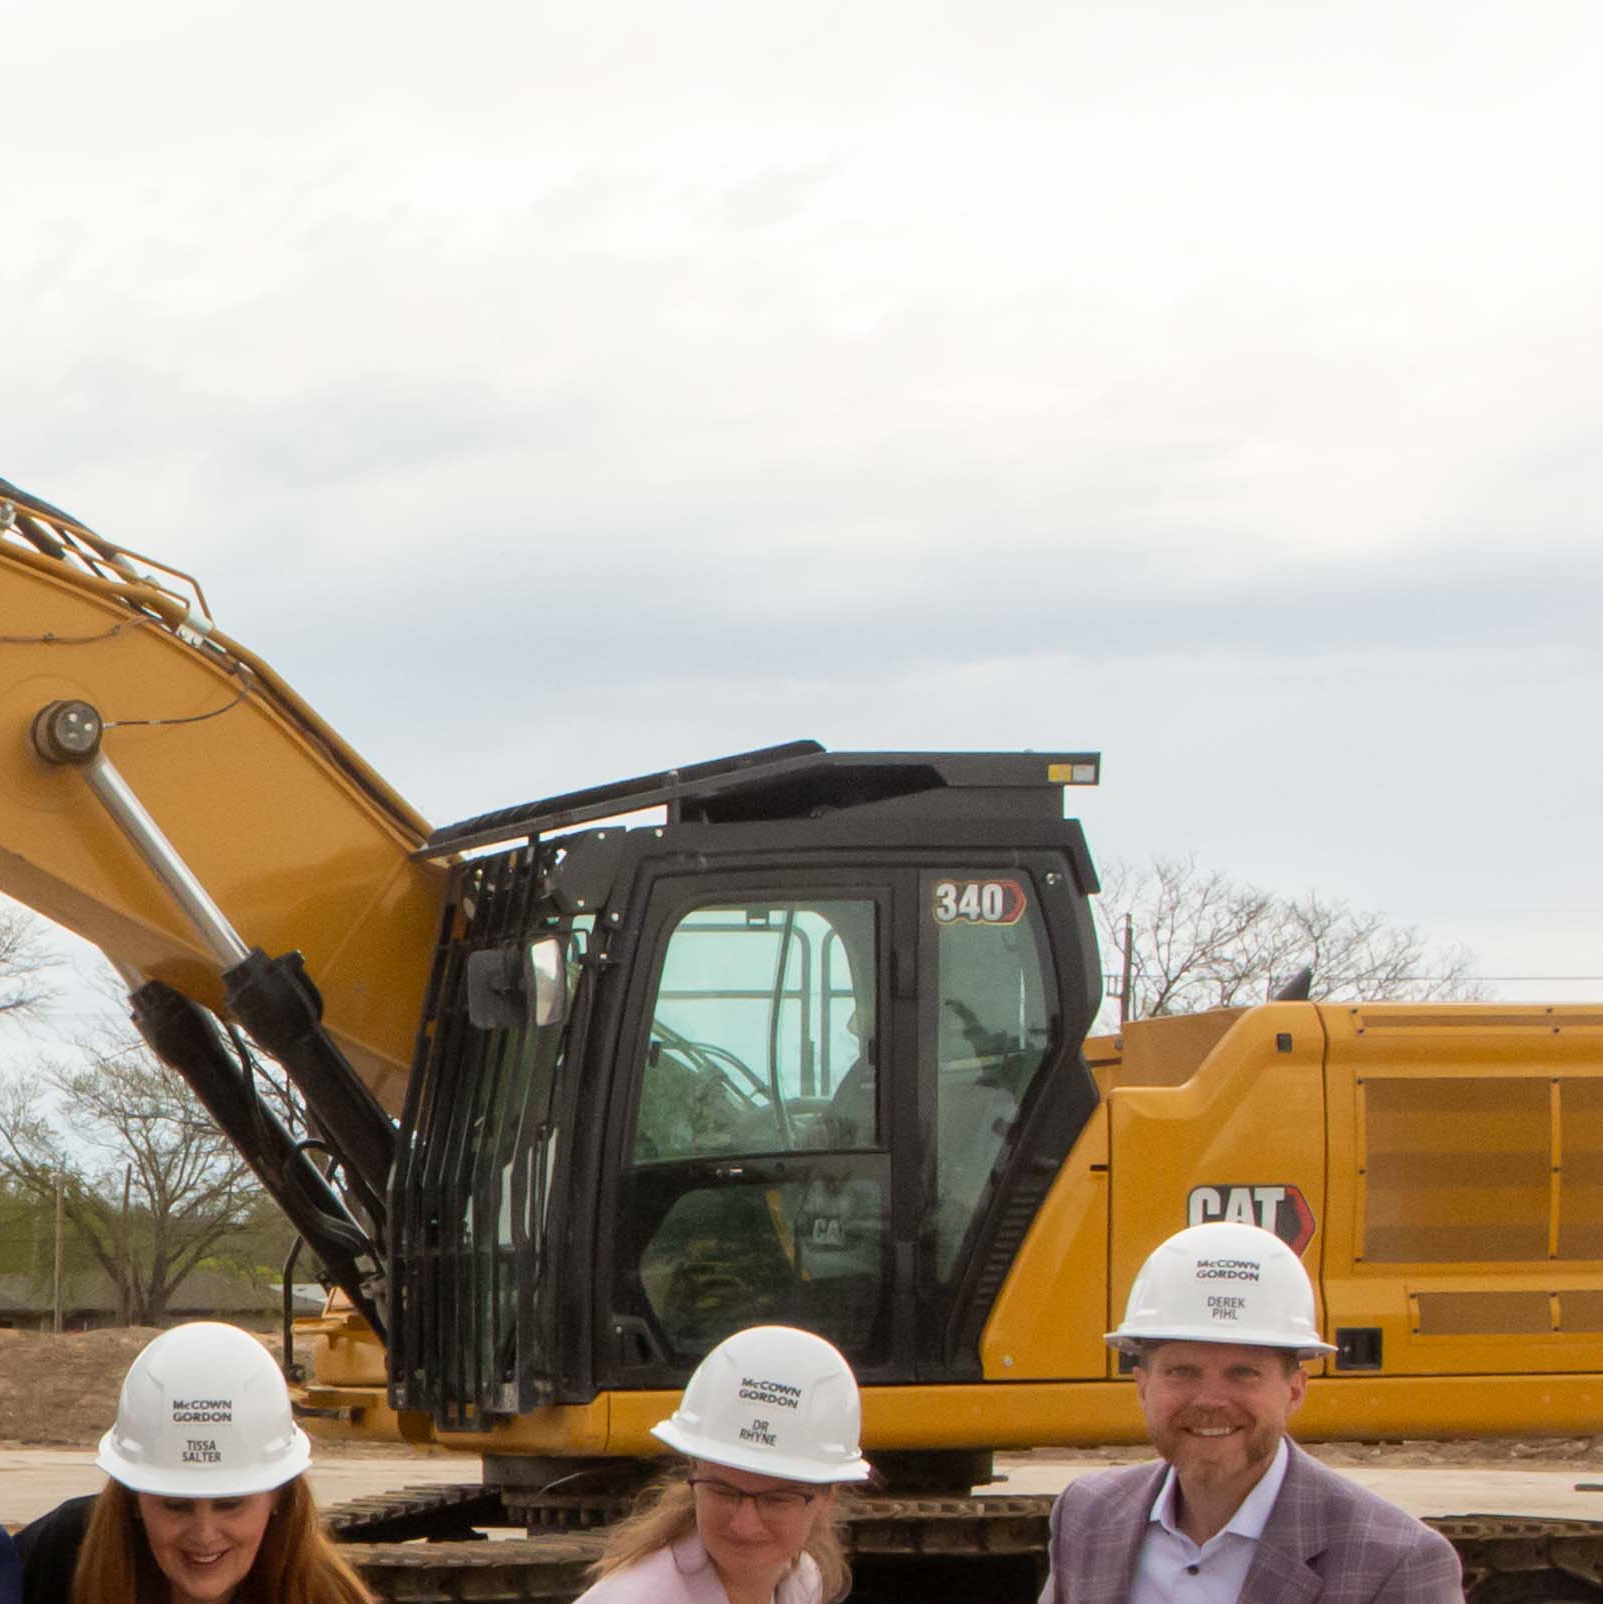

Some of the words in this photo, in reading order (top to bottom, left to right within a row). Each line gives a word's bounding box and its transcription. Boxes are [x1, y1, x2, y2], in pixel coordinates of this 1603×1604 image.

[935, 883, 1004, 922] 340
[1192, 1187, 1286, 1233] CAT
[1196, 1258, 1260, 1271] McCOWN
[1195, 1269, 1260, 1282] GORDON
[1206, 1295, 1246, 1309] DEREK
[1211, 1307, 1238, 1320] PIHL
[741, 1377, 802, 1398] McCOWN
[172, 1399, 233, 1410] McCOWN
[738, 1387, 799, 1409] GORDON
[172, 1412, 233, 1423] GORDON
[752, 1419, 770, 1432] DR
[739, 1427, 778, 1448] RHYNE
[186, 1439, 217, 1451] TISSA
[181, 1451, 222, 1463] SALTER
